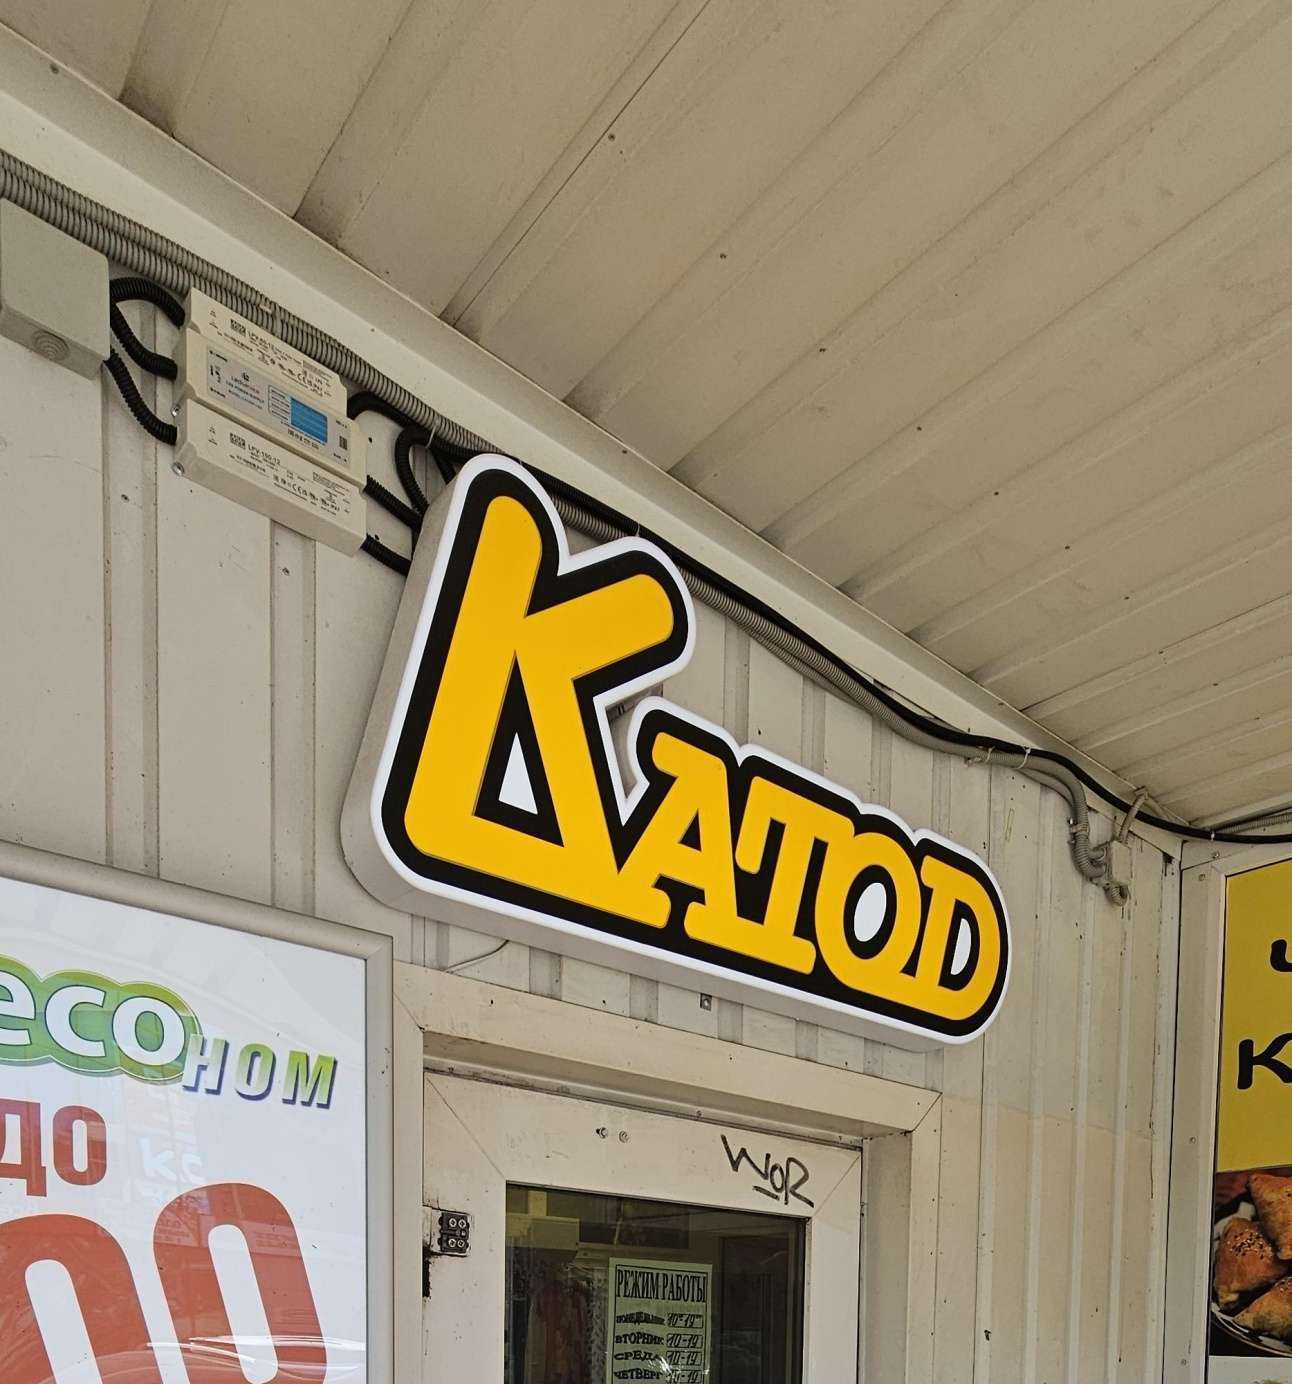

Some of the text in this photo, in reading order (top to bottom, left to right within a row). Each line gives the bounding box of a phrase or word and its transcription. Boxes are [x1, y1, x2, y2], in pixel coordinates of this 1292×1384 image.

[616, 1268, 706, 1303] РЕЖИМ РАБОТЫ
[615, 1332, 664, 1345] ВТОРНИК
[614, 1350, 663, 1361] СРЕДА
[614, 1368, 663, 1380] ЧЕТВЕРГ
